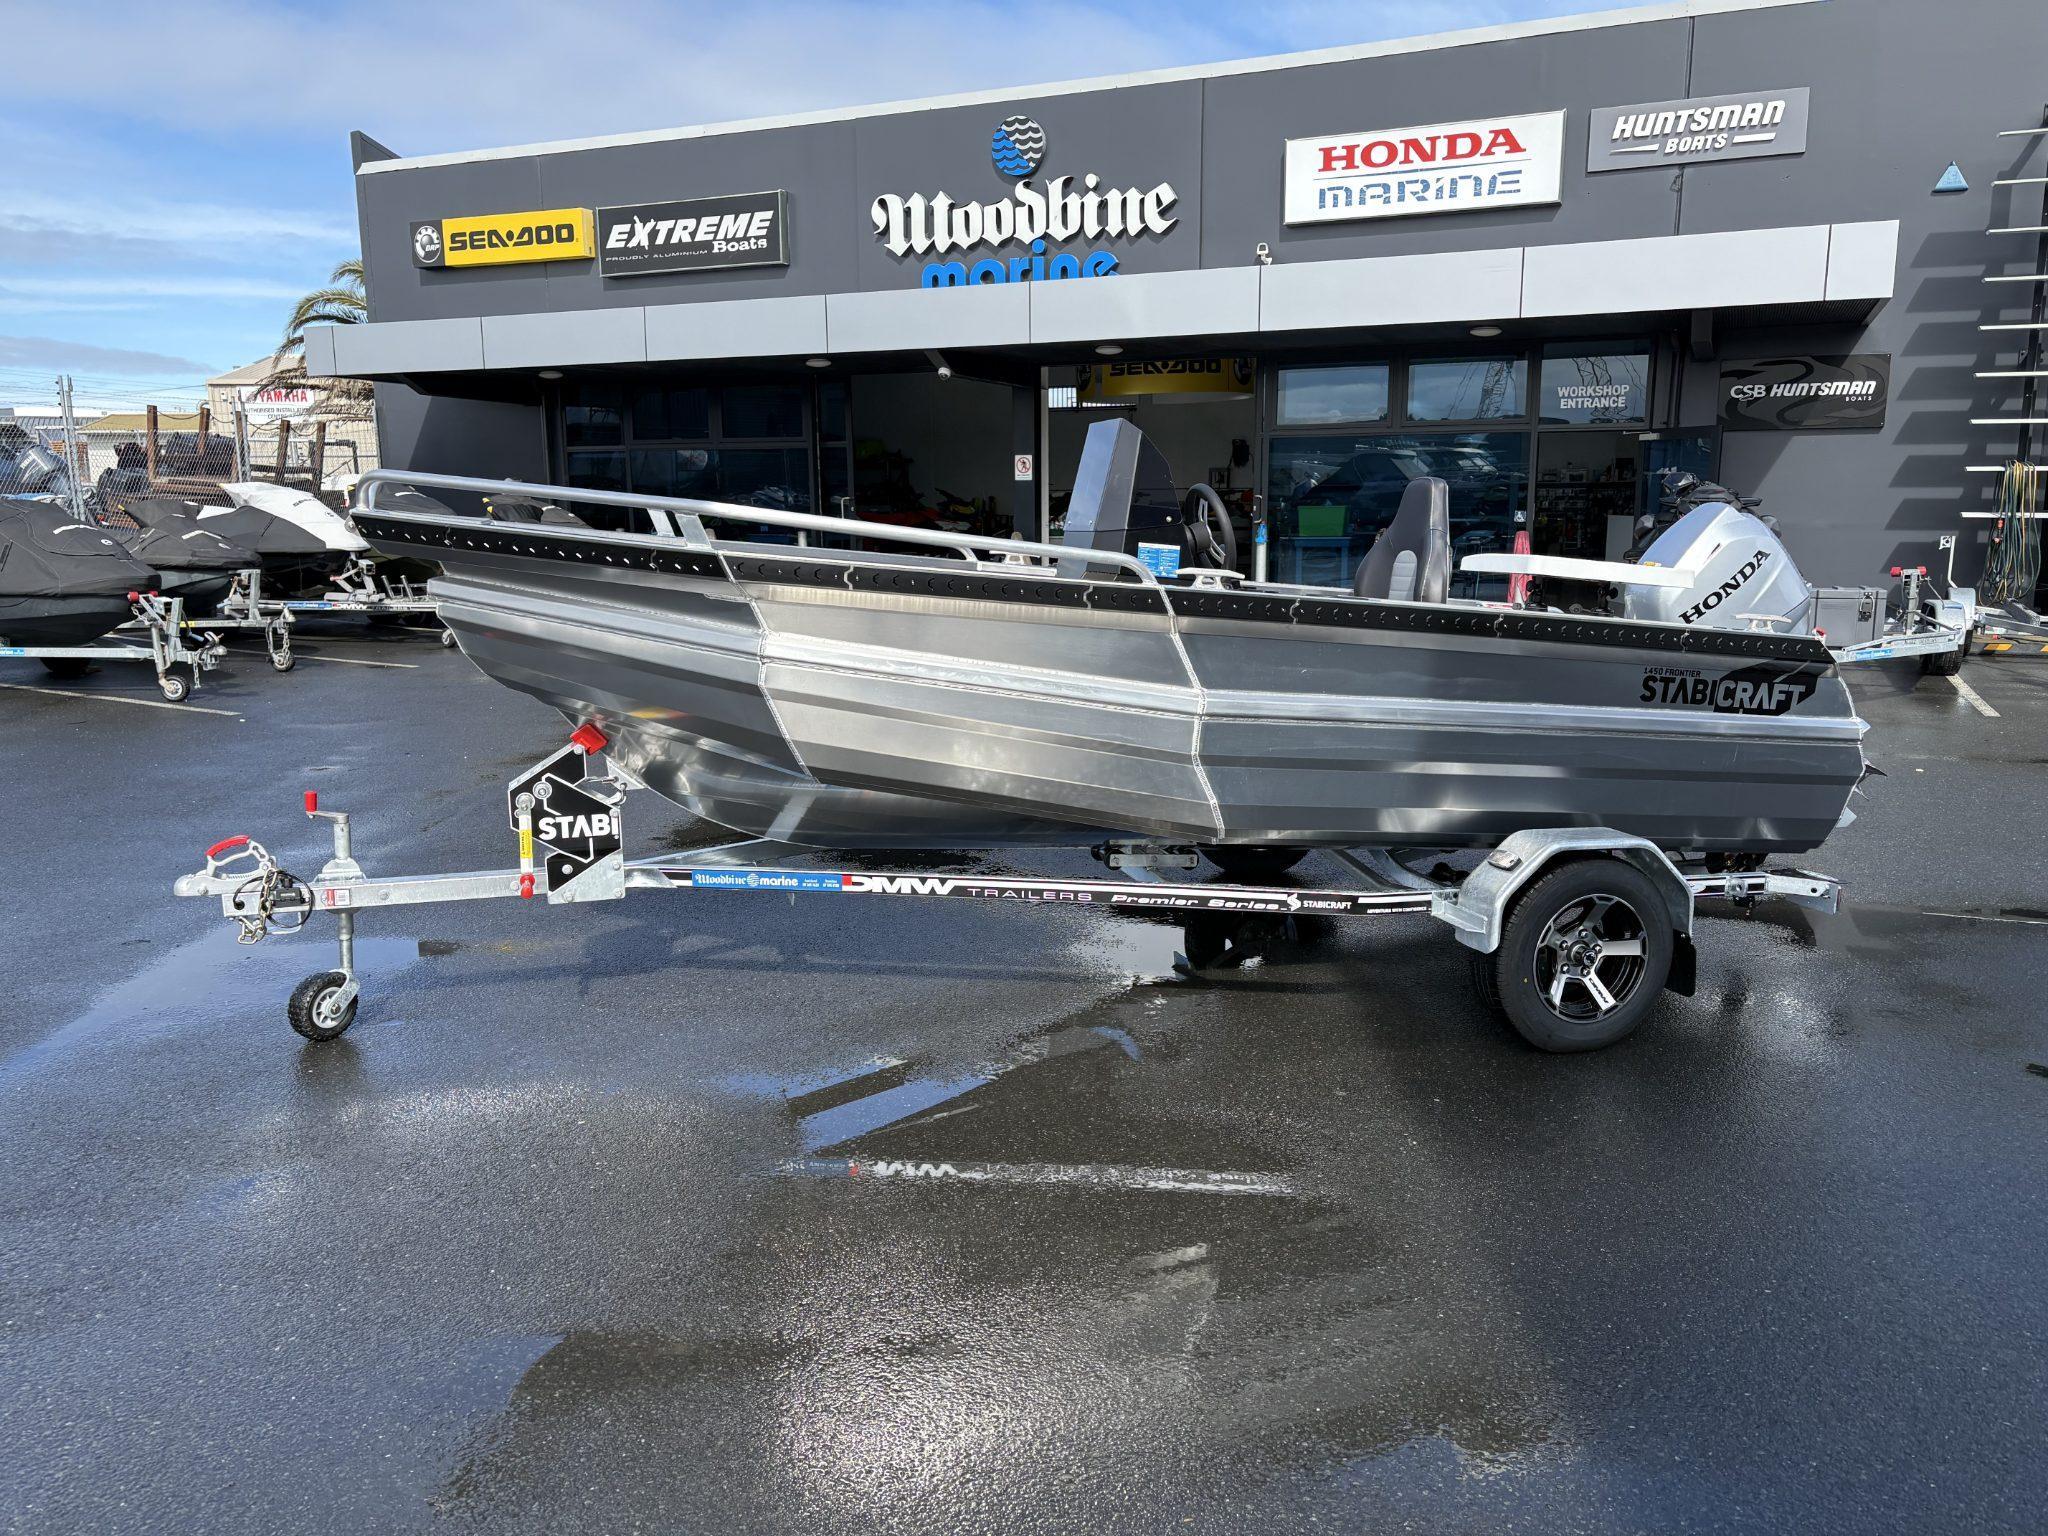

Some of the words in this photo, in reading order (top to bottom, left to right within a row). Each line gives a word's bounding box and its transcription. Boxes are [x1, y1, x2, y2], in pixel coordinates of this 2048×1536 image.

[1611, 99, 1786, 141] HUNTSMAN
[1317, 127, 1527, 173] HONDA
[1664, 132, 1728, 155] BOATS
[1318, 168, 1524, 210] MARINE
[871, 172, 1179, 258] Woodbine
[605, 210, 775, 250] EXTREME
[605, 253, 650, 262] PROUDLY
[652, 249, 708, 259] ALUMINIUM
[711, 237, 768, 254] Boats
[259, 388, 309, 403] YAMAHA
[1557, 384, 1630, 398] WORKSHOP
[1730, 384, 1767, 401] CSB
[1769, 380, 1877, 397] HUNTSMAN
[1560, 396, 1626, 409] ENTRANCE
[1679, 550, 1771, 624] HONDA
[1644, 667, 1663, 675] 1450
[1664, 668, 1702, 677] FRONTIER
[1639, 674, 1806, 711] STABICRAFT
[538, 813, 619, 841] STABI
[695, 872, 747, 885] Woodbine
[759, 876, 799, 887] marine
[842, 874, 957, 895] DMW
[967, 888, 1092, 901] TRAILERS
[1110, 894, 1199, 906] Premier
[1207, 899, 1279, 910] Series
[1303, 900, 1353, 910] STABICRAFT
